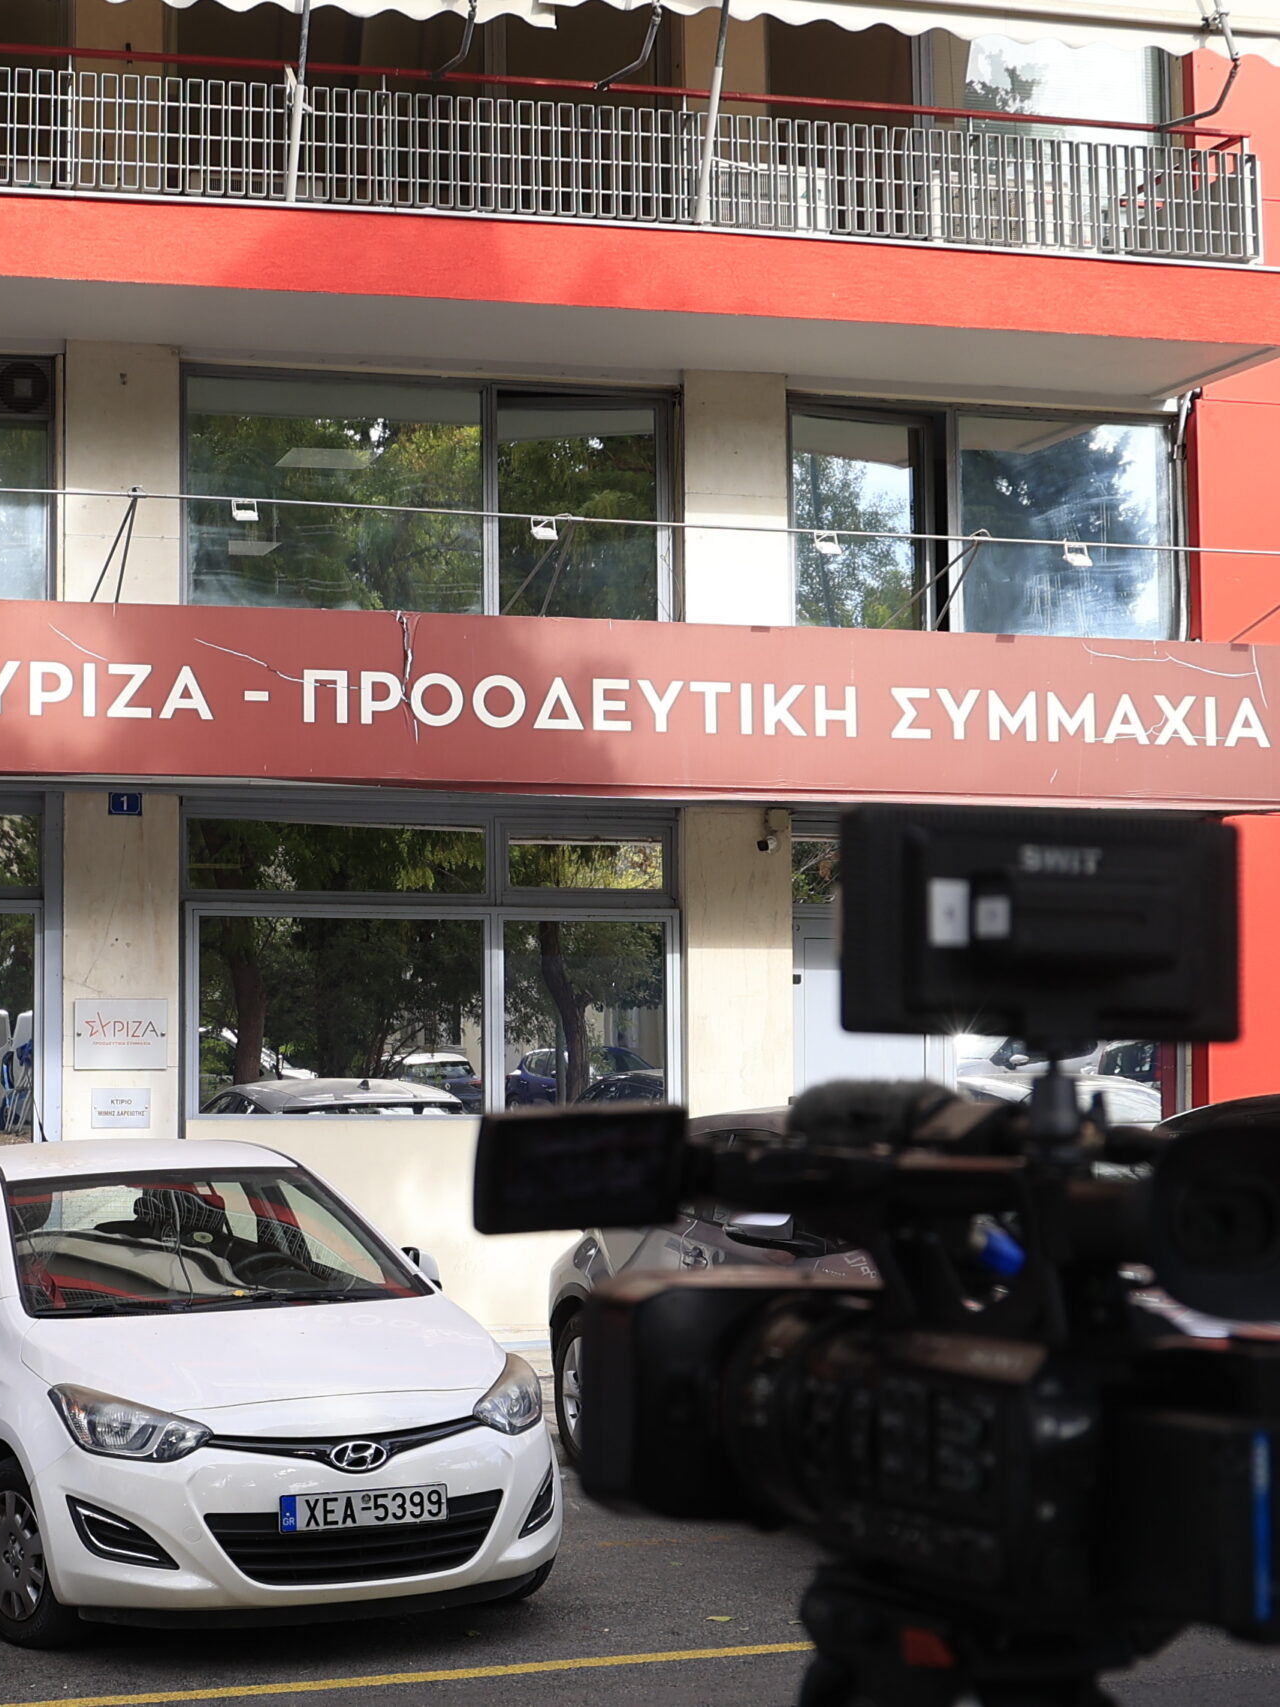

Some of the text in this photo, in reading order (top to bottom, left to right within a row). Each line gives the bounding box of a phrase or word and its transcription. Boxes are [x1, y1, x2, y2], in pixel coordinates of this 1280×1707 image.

[303, 669, 858, 738] ΠΡΟΟΔΕΥΤΙΚΗ
[890, 687, 1271, 748] ΣΥΜΜΑΧΙΑ
[120, 795, 128, 811] 1
[84, 1012, 159, 1038] ΣΥΡΙΖΑ
[282, 1516, 295, 1526] GR
